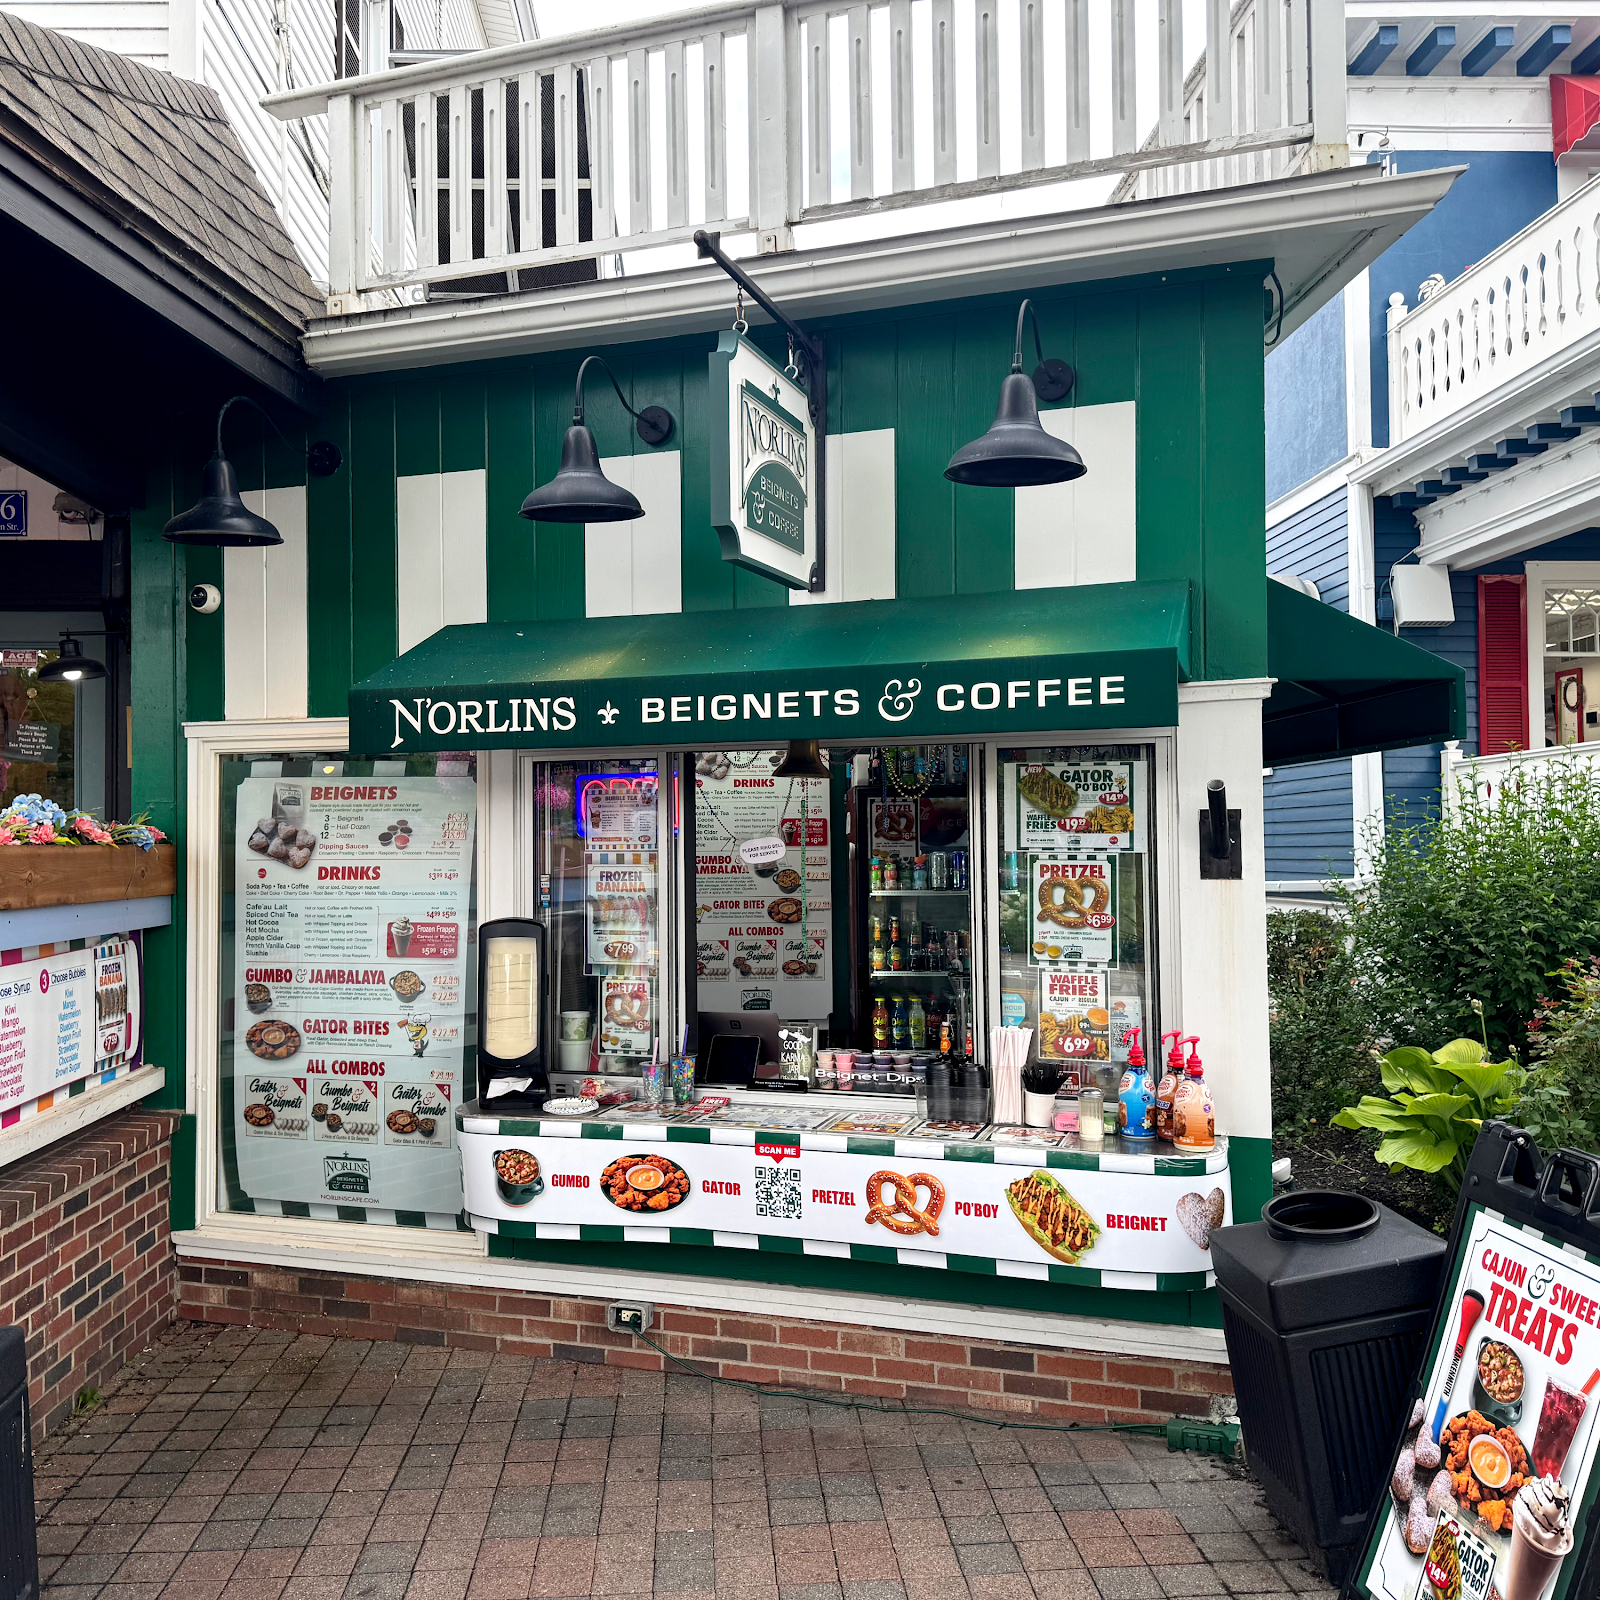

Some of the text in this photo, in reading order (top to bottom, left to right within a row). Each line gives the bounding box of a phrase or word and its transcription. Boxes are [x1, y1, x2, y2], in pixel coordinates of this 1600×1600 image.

[760, 475, 798, 510] BEIGNETS
[0, 495, 15, 520] 6
[751, 490, 798, 540] & COFFEE
[6, 523, 19, 531] Str.
[641, 688, 861, 724] BEIGNETS
[878, 676, 921, 723] &
[937, 674, 1127, 713] COFFEE
[1027, 766, 1042, 774] NEW
[1059, 769, 1113, 783] GATOR
[733, 778, 774, 788] DRINKS
[1075, 782, 1113, 792] PO'BOY
[310, 786, 399, 801] BEIGNETS
[324, 814, 364, 823] 3 Beignets
[1026, 820, 1056, 829] FRIES
[324, 823, 370, 831] 6 Half-Dozen
[742, 846, 759, 854] PLEASE
[760, 844, 771, 852] RING
[317, 866, 381, 881] DRINKS
[600, 870, 642, 881] FROZEN
[1039, 864, 1106, 879] PRETZEL
[596, 882, 646, 892] BANANA
[713, 900, 765, 910] GATOR BITES
[728, 926, 783, 936] ALL COMBOS
[286, 942, 301, 950] Capp
[102, 962, 121, 976] FROZEN
[42, 967, 86, 988] 3 Choose Bubbles
[100, 972, 122, 988] BANANA
[246, 968, 387, 985] GUMBO & JAMBALAYA
[1049, 974, 1098, 985] WAFFLE
[14, 982, 30, 996] Syrup
[64, 988, 73, 999] Kiwi
[606, 982, 647, 993] PRETZEL
[1049, 984, 1098, 996] FRIES
[4, 1004, 16, 1016] Kiwi
[62, 1000, 76, 1011] Mango
[58, 1008, 81, 1022] Watermelon
[2, 1016, 19, 1030] Mango
[60, 1020, 79, 1033] Blueberry
[302, 1018, 390, 1036] GATOR BITES
[57, 1030, 81, 1046] Dragon Fruit
[784, 1040, 803, 1050] GOOD
[14, 1048, 25, 1061] Fruit
[58, 1042, 80, 1056] Strawberry
[58, 1053, 78, 1067] Chocolate
[780, 1052, 805, 1062] KARMA
[56, 1062, 81, 1079] Brown Sugar
[306, 1059, 386, 1077] ALL COMBOS
[787, 1064, 799, 1074] JAR
[816, 1068, 880, 1082] Beignet
[10, 1084, 25, 1097] Sugar
[250, 1079, 288, 1099] Gator &
[300, 1080, 304, 1089] 1
[370, 1082, 376, 1091] 2
[444, 1086, 449, 1095] 3
[320, 1082, 363, 1102] Gumbo &
[392, 1084, 435, 1105] Gator &
[264, 1093, 302, 1113] Beignets
[332, 1097, 371, 1117] Beignets
[412, 1100, 447, 1117] Gumbo
[758, 1145, 796, 1155] SCAN ME
[332, 1180, 341, 1189] &
[551, 1173, 590, 1189] GUMBO
[702, 1180, 741, 1196] GATOR
[320, 1194, 379, 1204] NORLINSCAFE.COM
[812, 1188, 855, 1207] PRETZEL
[954, 1200, 998, 1218] PO'BOY
[1106, 1212, 1168, 1232] BEIGNET
[1481, 1248, 1527, 1289] CAJUN
[1527, 1264, 1554, 1300] &
[1484, 1281, 1580, 1366] TREATS
[1442, 1343, 1463, 1398] FRANKENMUTH
[1448, 1523, 1459, 1537] NEW
[1458, 1540, 1489, 1582] GATOR
[1462, 1568, 1485, 1595] PO'BOY
